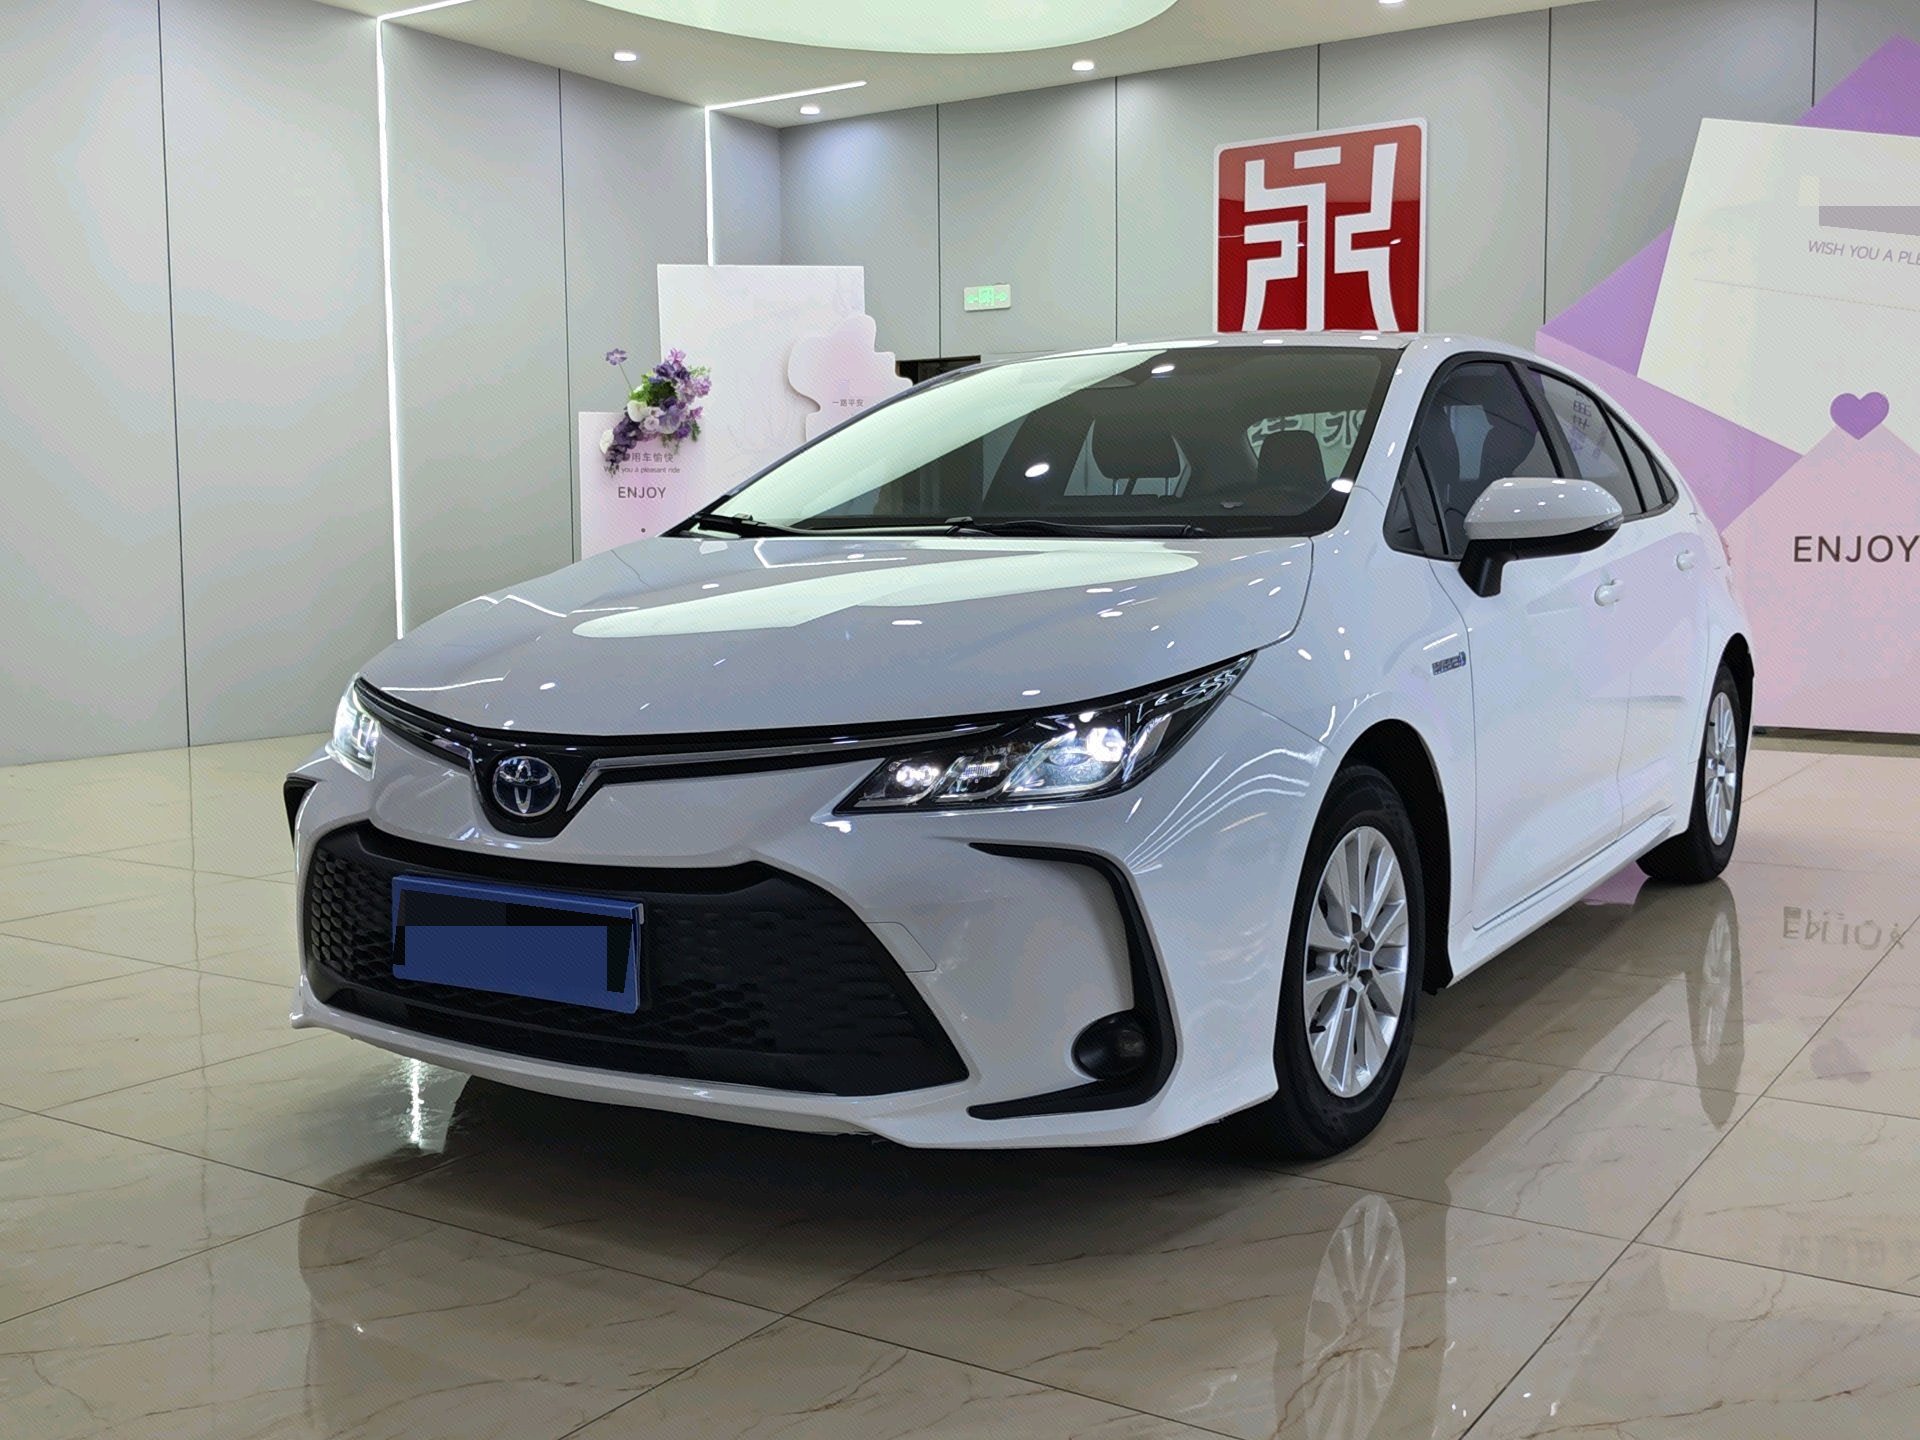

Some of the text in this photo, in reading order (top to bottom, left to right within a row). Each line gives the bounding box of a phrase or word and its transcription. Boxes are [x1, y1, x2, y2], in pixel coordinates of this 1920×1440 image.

[1808, 240, 1845, 257] WISH
[1850, 245, 1880, 260] YOU
[1882, 249, 1893, 262] A
[631, 452, 674, 463] 用车愉快
[641, 466, 667, 474] pleasant
[617, 486, 667, 499] ENJOY
[1794, 535, 1920, 563] ENJOY
